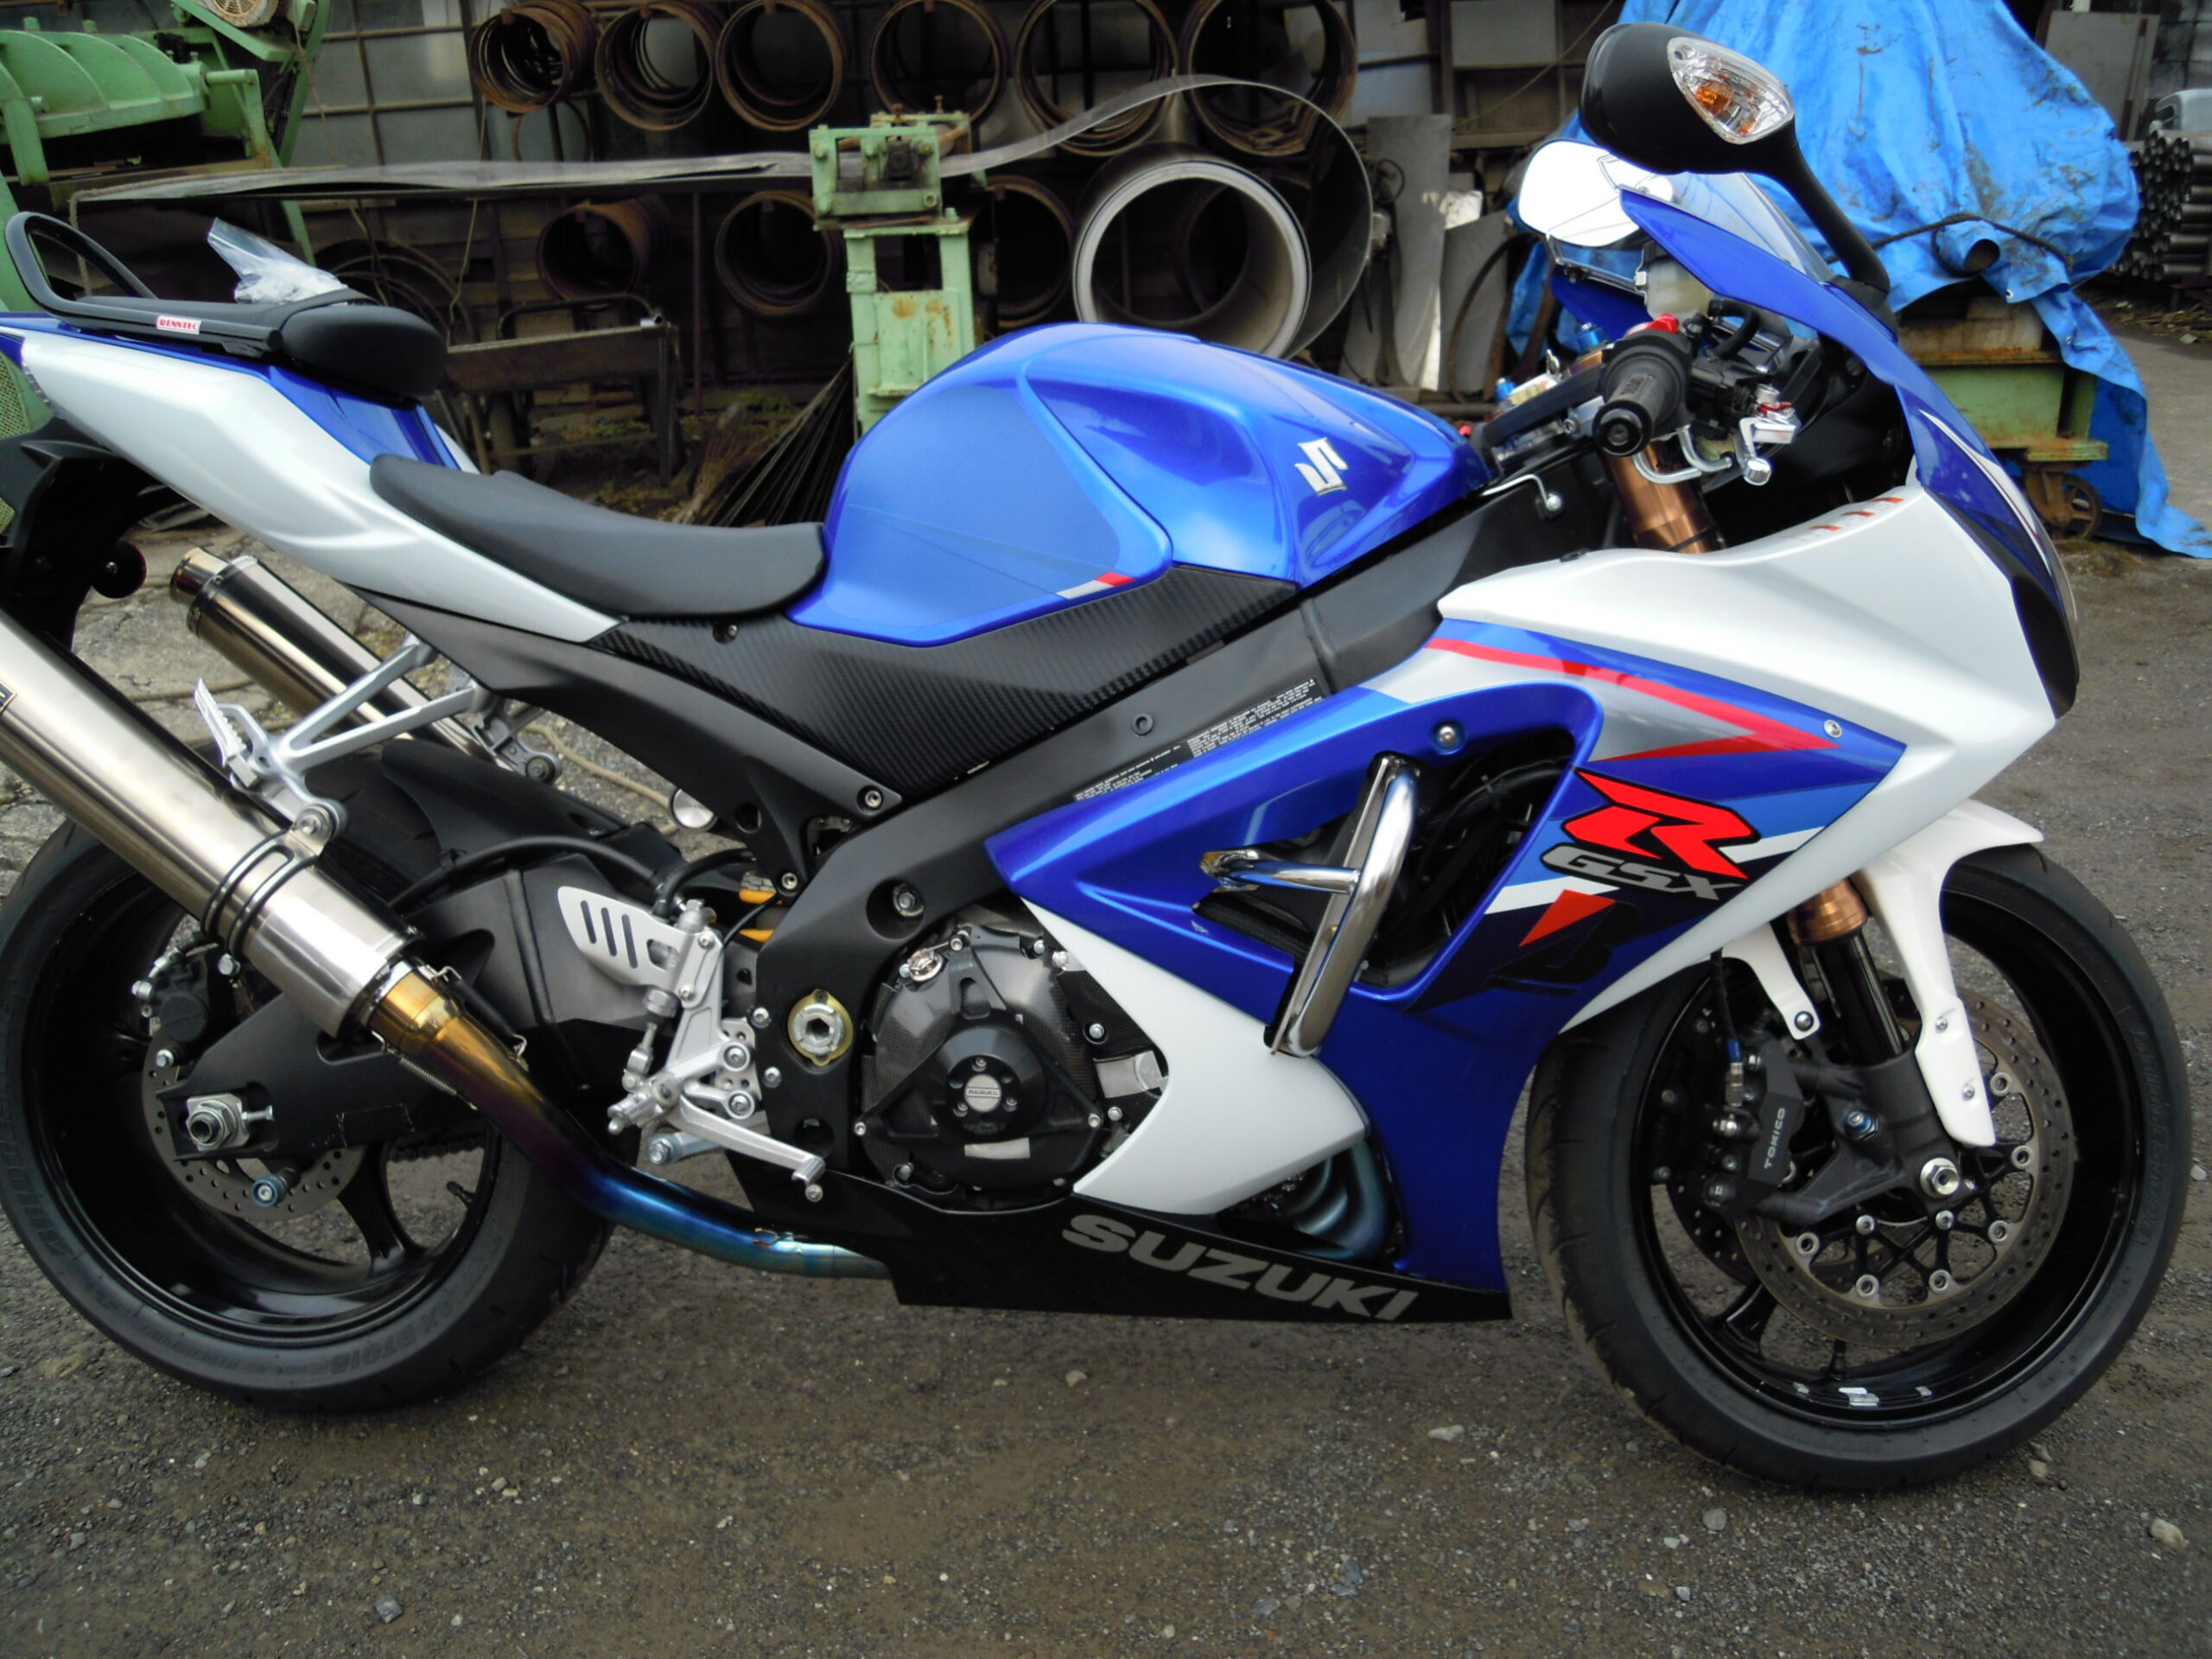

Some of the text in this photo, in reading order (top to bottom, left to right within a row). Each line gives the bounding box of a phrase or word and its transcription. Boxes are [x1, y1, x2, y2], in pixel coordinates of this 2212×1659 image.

[1541, 846, 1744, 900] GSX
[1764, 1108, 1786, 1169] TOKICO
[1061, 1213, 1419, 1321] SUZUKI
